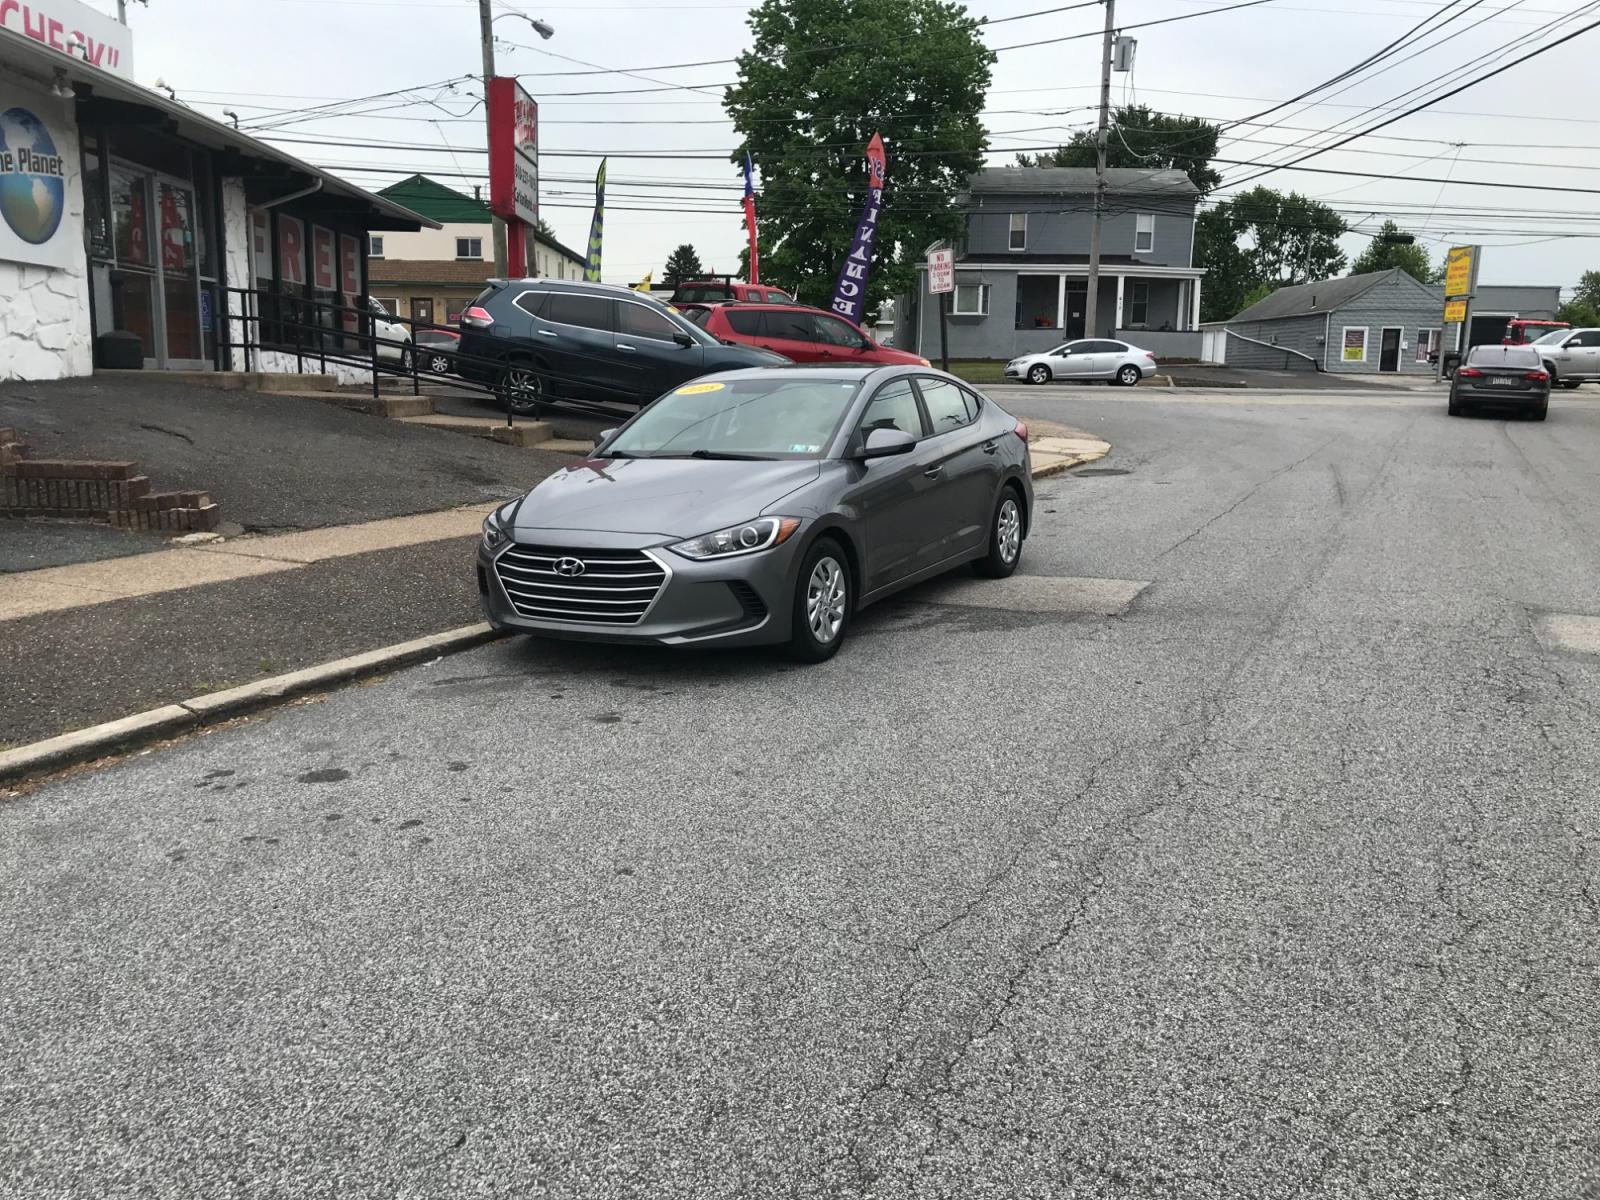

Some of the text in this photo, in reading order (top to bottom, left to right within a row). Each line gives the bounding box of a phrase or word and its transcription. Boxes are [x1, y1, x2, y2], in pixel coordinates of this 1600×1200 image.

[18, 147, 65, 177] Planet
[936, 252, 945, 262] NO
[930, 262, 951, 272] PARKING
